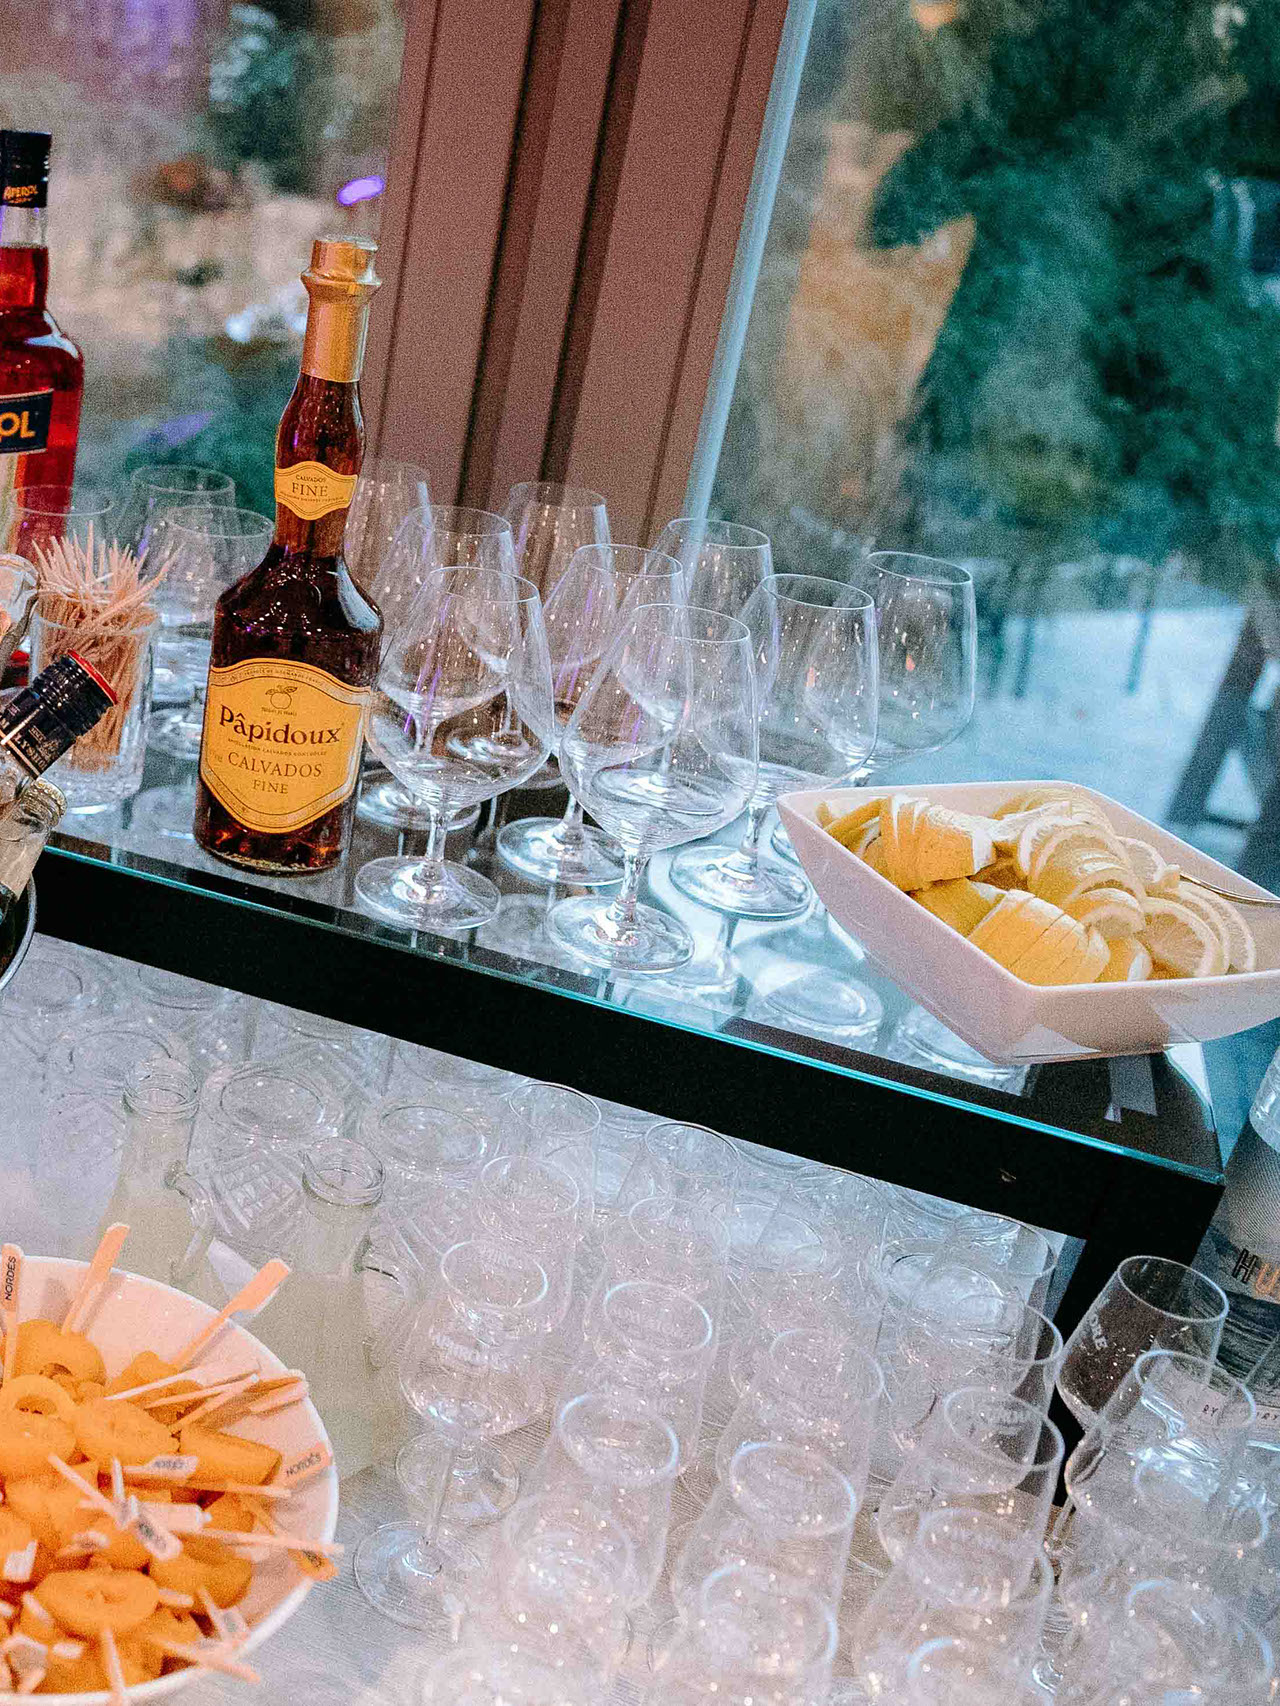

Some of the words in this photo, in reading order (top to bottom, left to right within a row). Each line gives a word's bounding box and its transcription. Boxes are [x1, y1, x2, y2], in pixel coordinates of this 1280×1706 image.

[292, 482, 328, 497] FINE
[219, 703, 341, 745] Pâpidoux
[228, 752, 322, 778] CALVADOS
[253, 779, 288, 795] FINE
[4, 1255, 17, 1301] NORDÉS
